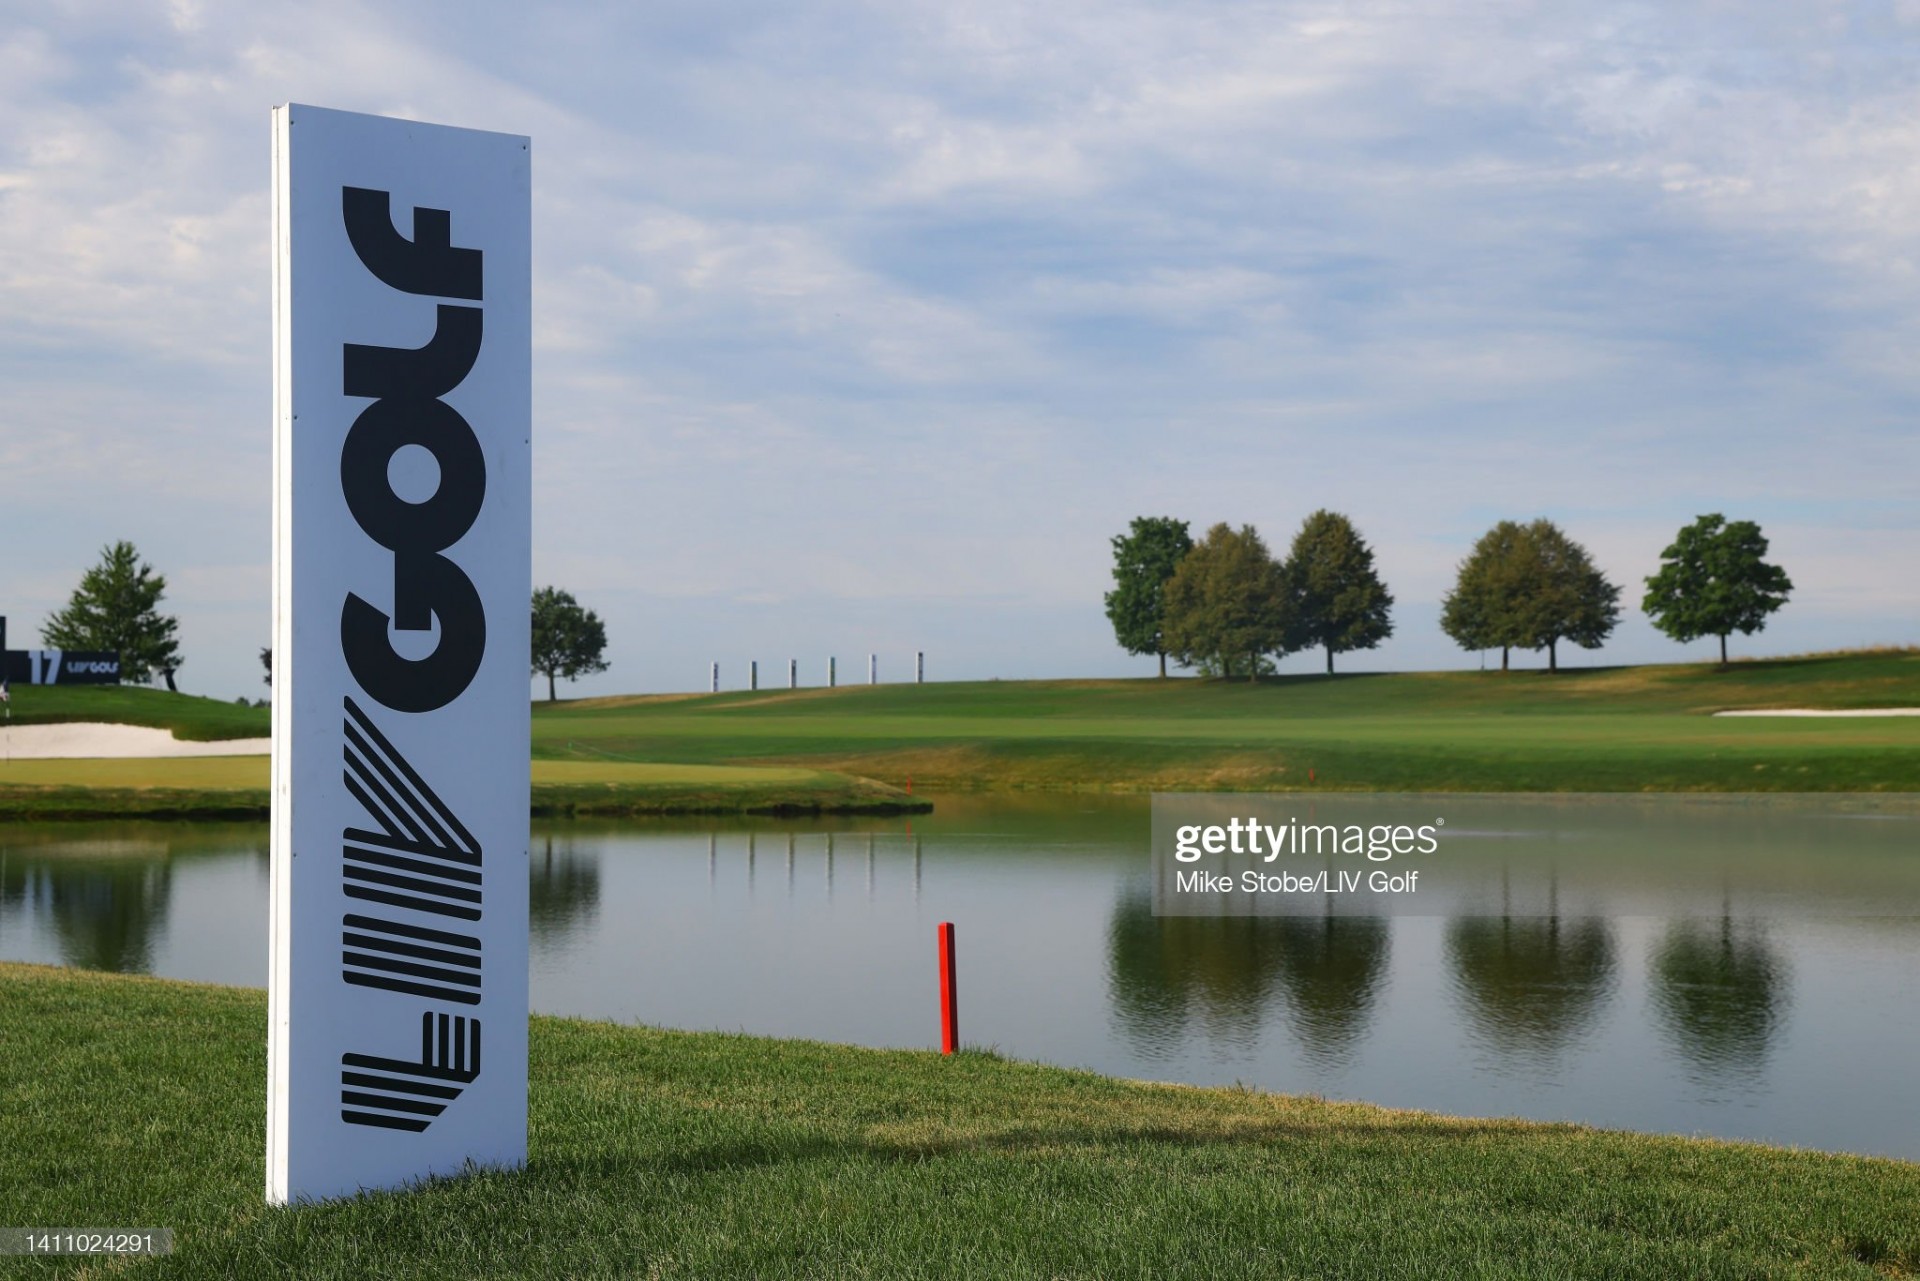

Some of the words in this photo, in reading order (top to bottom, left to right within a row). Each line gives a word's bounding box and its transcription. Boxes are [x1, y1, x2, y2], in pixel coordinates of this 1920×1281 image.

[28, 649, 62, 684] 17
[341, 186, 486, 713] GOLF
[342, 695, 482, 1132] LIV
